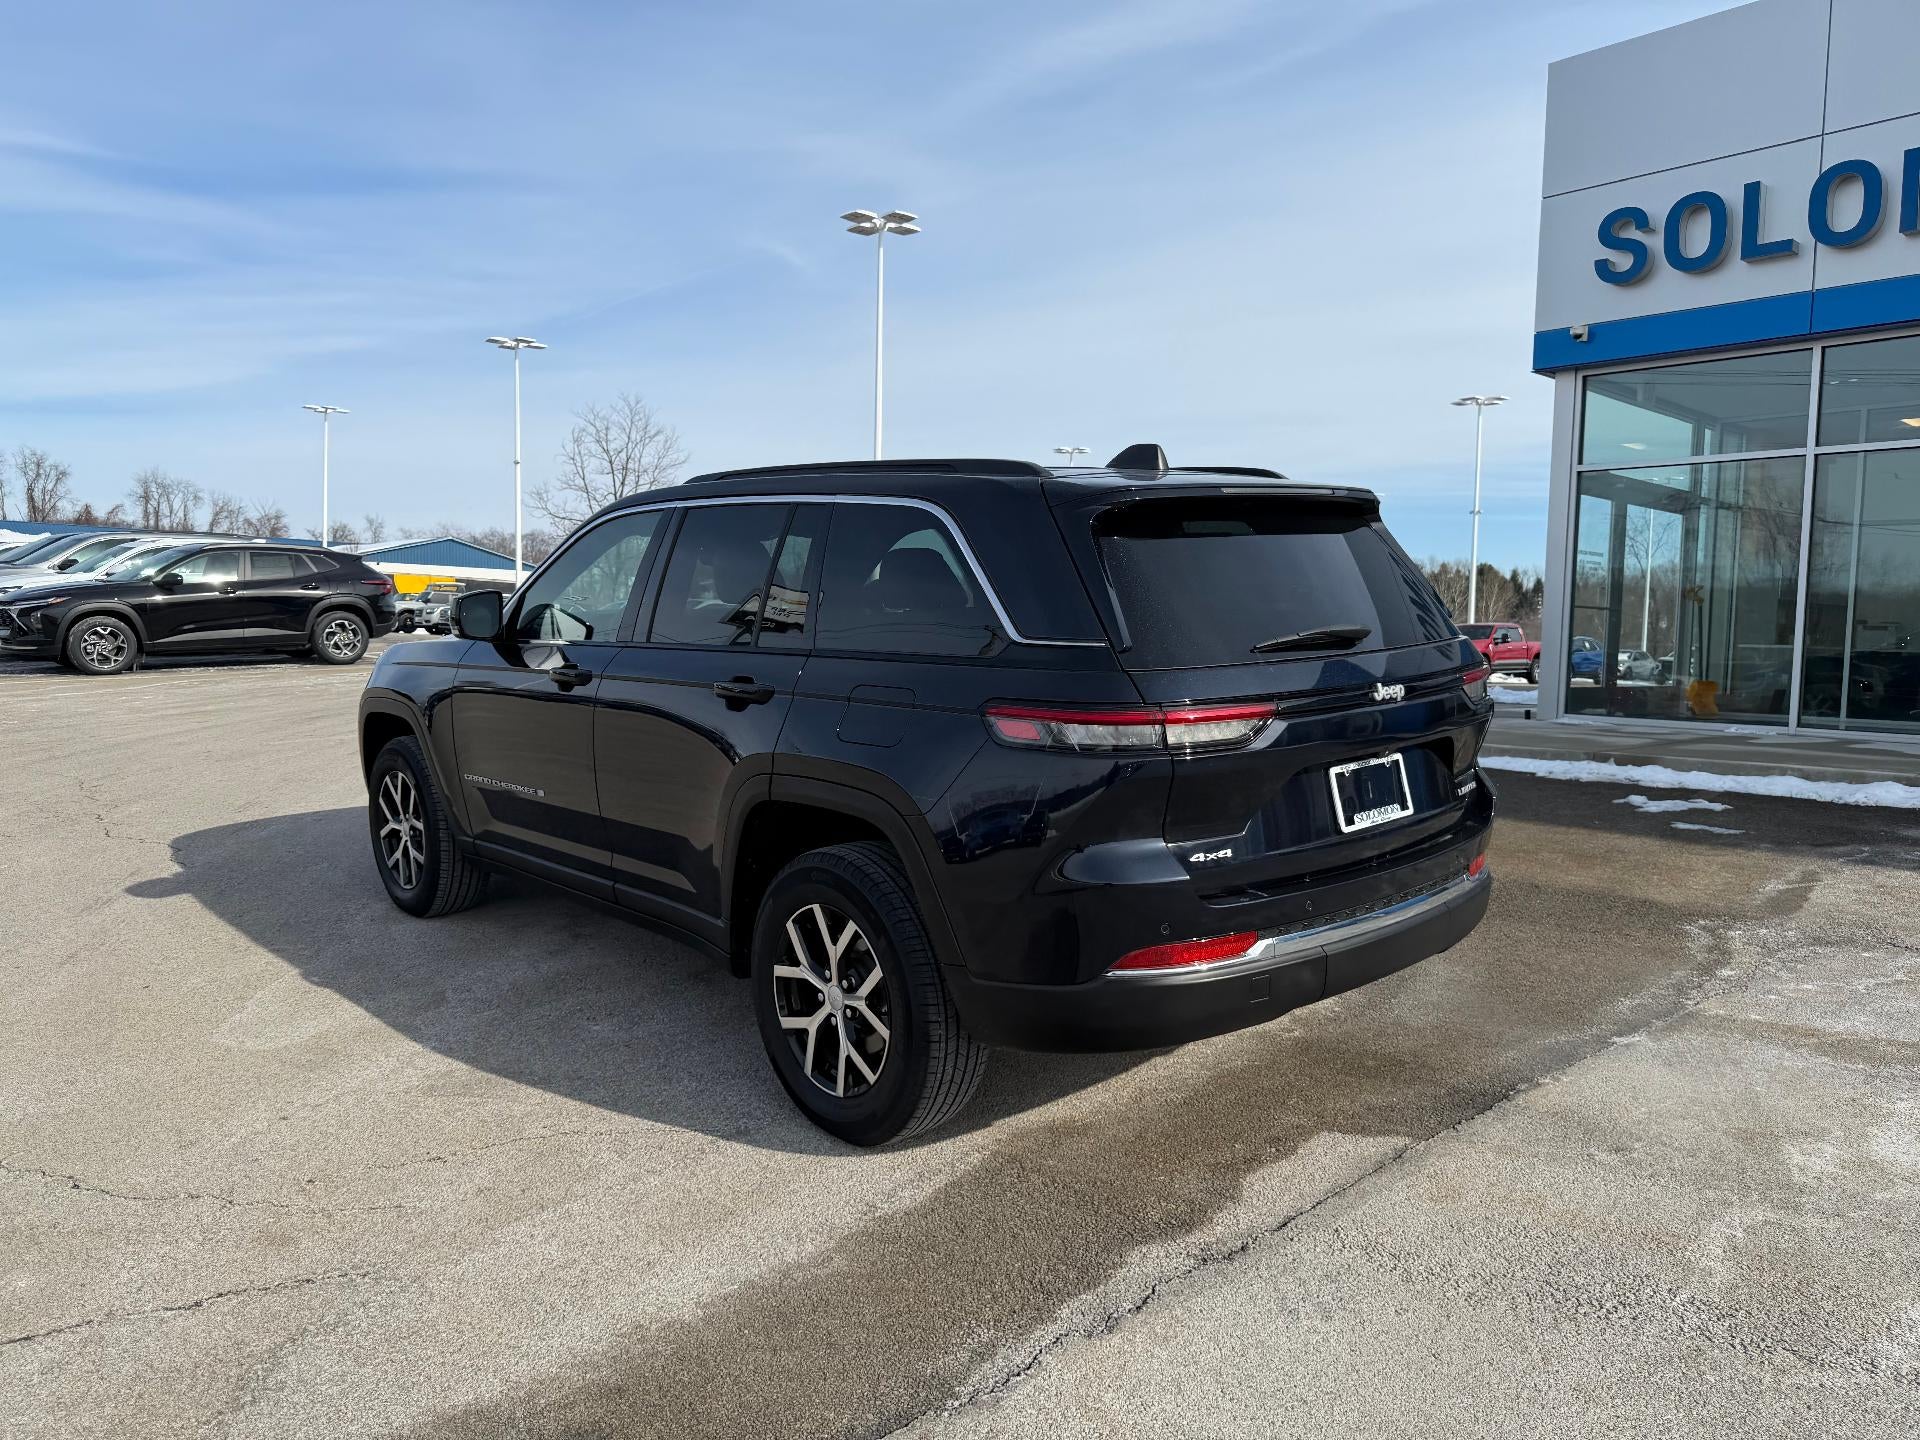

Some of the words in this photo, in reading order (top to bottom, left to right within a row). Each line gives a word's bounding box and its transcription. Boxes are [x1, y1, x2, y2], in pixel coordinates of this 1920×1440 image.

[1594, 147, 1920, 286] SOLO
[1373, 683, 1405, 701] Jeep
[464, 773, 491, 785] GRAND
[492, 780, 536, 795] CHEROKEE
[1355, 804, 1400, 823] SOLOMON
[1190, 849, 1232, 861] 4x4
